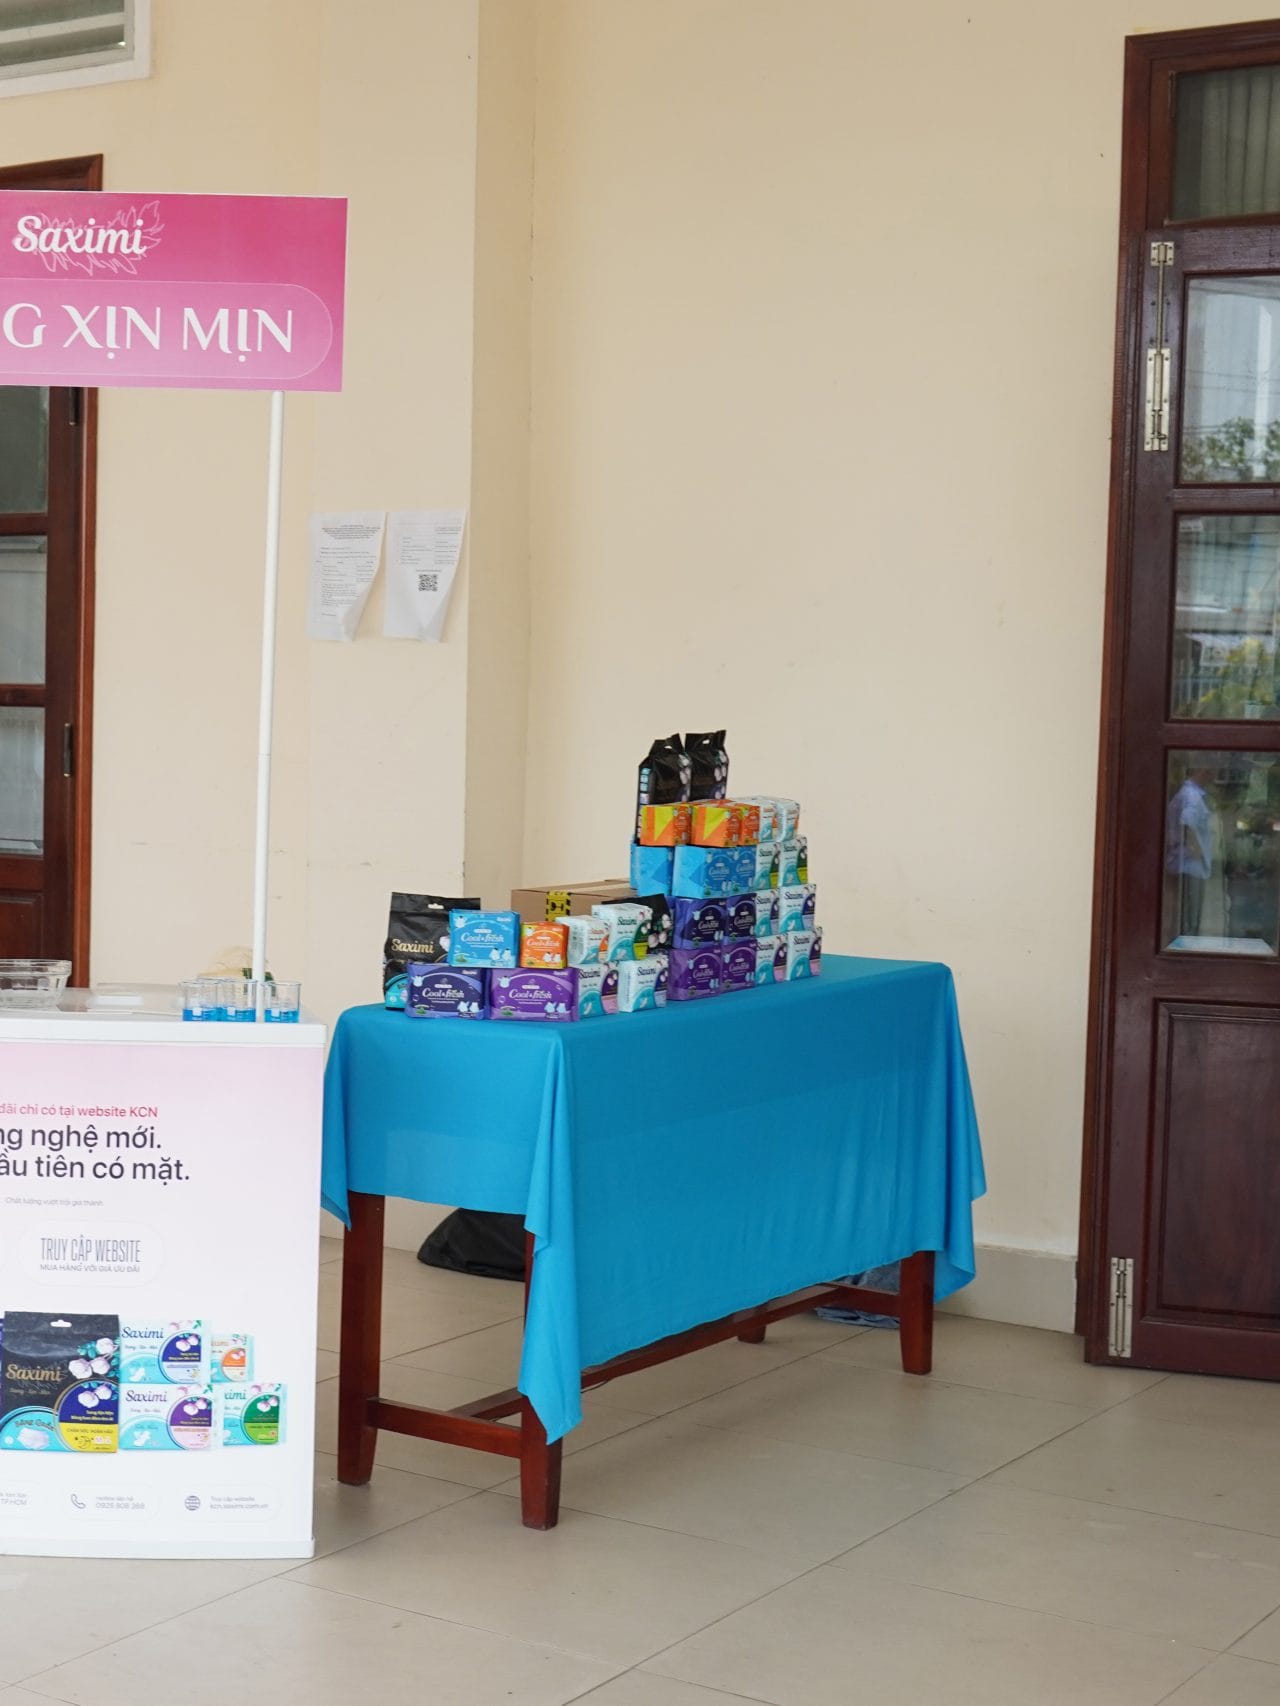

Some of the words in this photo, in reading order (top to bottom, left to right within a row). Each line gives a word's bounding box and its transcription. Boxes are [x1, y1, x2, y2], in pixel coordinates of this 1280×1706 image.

[13, 215, 147, 256] Saximi
[61, 304, 162, 360] XỊN
[182, 307, 293, 363] MỊN
[391, 938, 435, 954] Saximi
[19, 1103, 39, 1115] chỉ
[41, 1104, 56, 1115] có
[59, 1105, 75, 1118] tại
[77, 1105, 127, 1117] website
[129, 1107, 158, 1118] KCN
[31, 1125, 99, 1153] nghệ
[106, 1125, 162, 1149] mới.
[35, 1152, 85, 1178] tiên
[92, 1155, 125, 1179] có
[132, 1157, 190, 1186] mặt.
[40, 1238, 68, 1261] TRUY
[71, 1234, 92, 1265] CẬP
[95, 1239, 141, 1262] WEBSITE
[121, 1326, 165, 1339] Saximi
[6, 1364, 62, 1381] Saximi
[125, 1390, 168, 1402] Saximi
